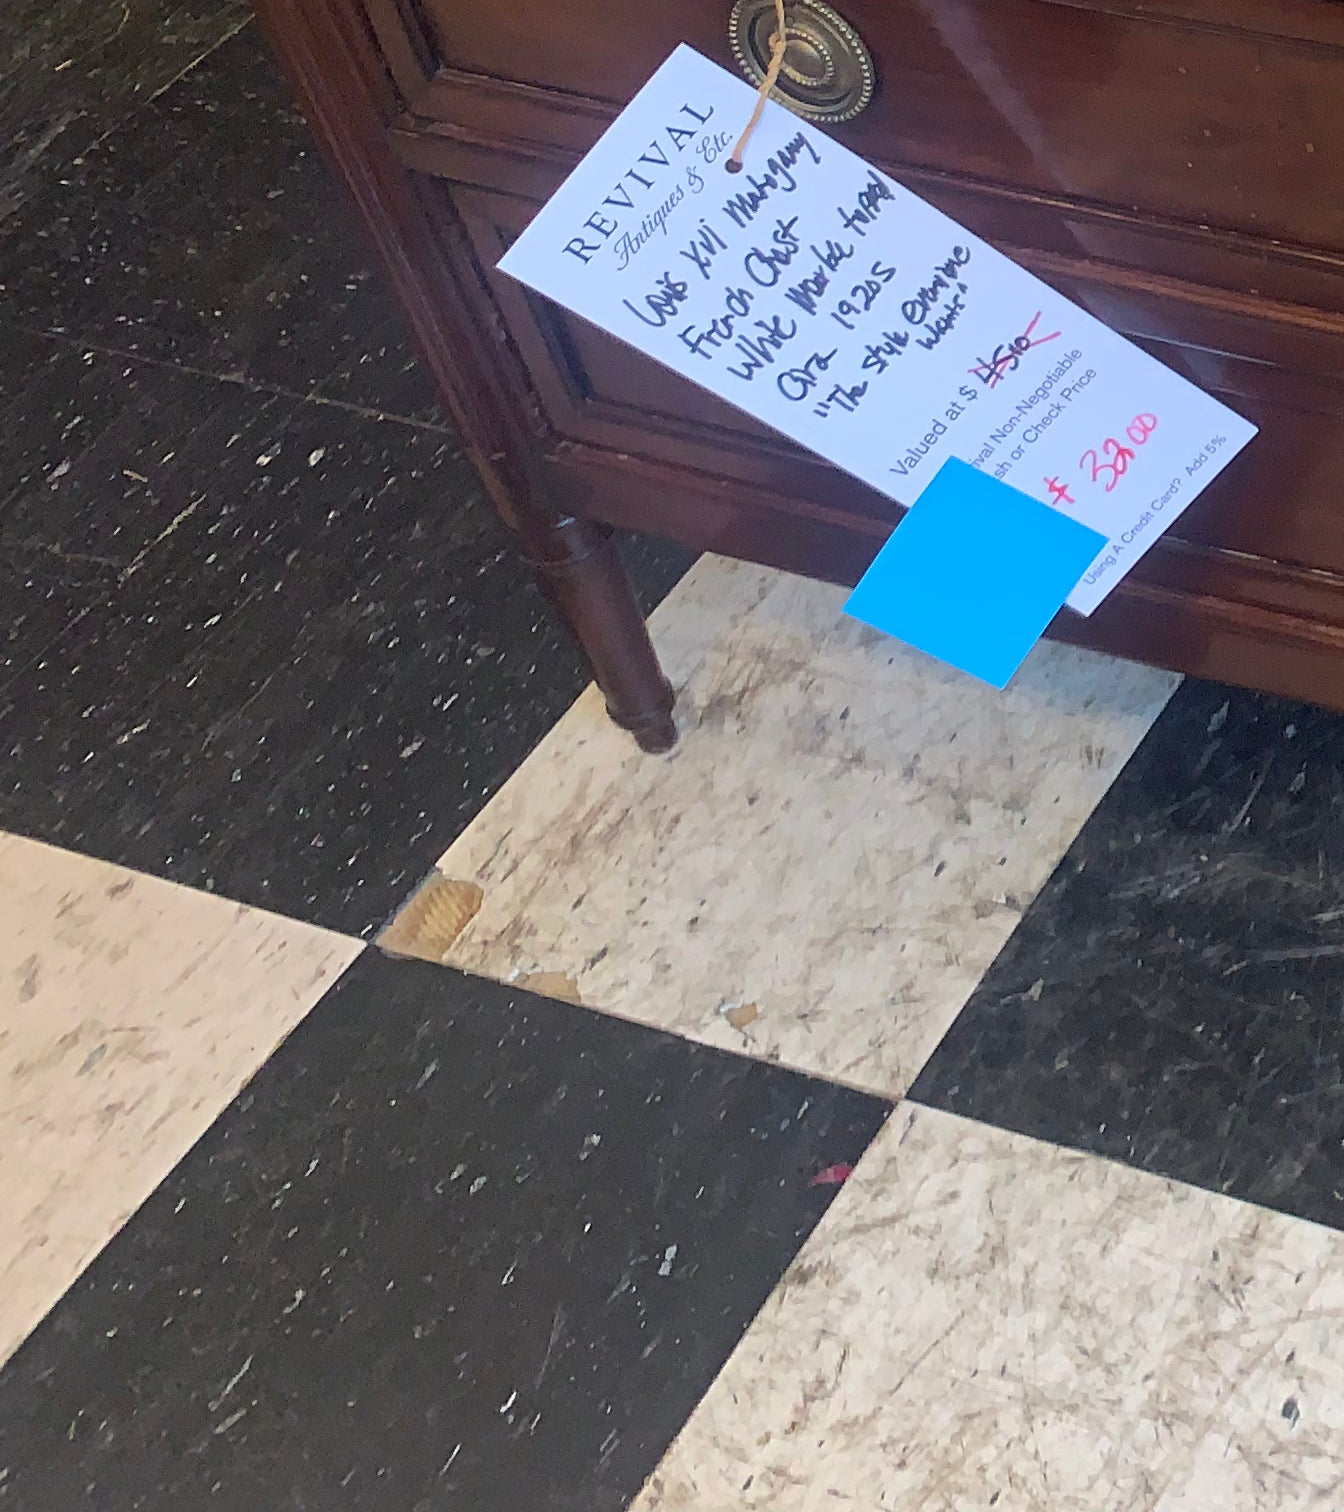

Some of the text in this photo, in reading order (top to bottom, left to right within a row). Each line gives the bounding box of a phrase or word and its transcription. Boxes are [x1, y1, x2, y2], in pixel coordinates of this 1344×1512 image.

[562, 103, 714, 265] REVIVAL
[614, 132, 733, 271] Antiques & Etc.
[677, 287, 754, 359] French
[890, 419, 948, 476] Valued
[945, 401, 966, 421] at
[968, 348, 1082, 469] ival Non-Negotiable
[1011, 444, 1026, 461] or
[1022, 402, 1066, 443] Check
[1060, 367, 1097, 402] Price
[1083, 434, 1227, 585] Using A Credit Card? Add 5%
